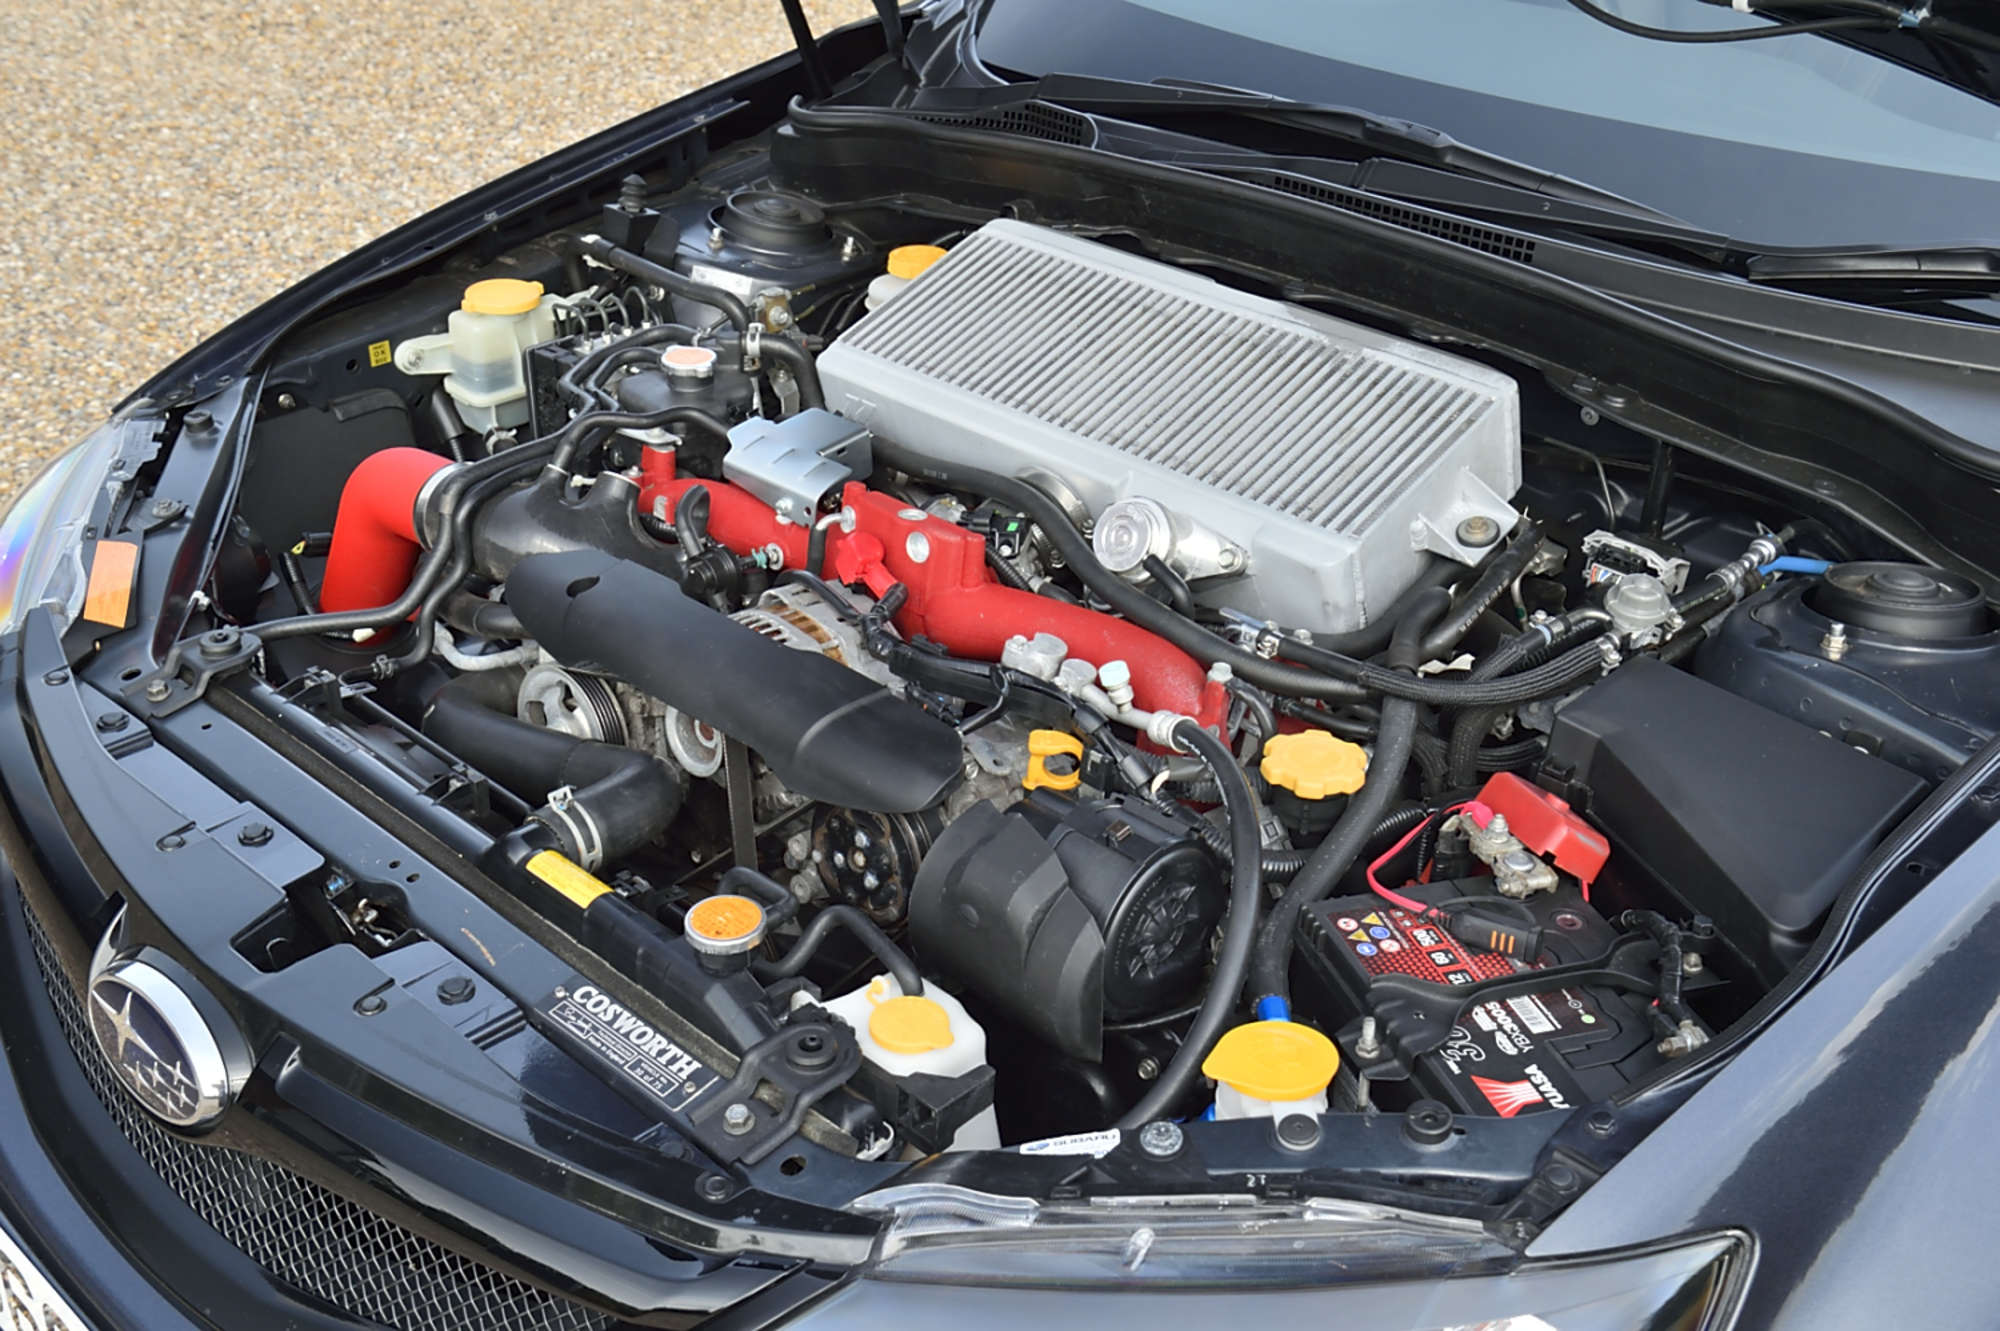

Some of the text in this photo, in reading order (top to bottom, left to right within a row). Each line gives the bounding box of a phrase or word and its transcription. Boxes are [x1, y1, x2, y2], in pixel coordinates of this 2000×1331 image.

[572, 985, 703, 1081] COSWORTH
[1484, 1000, 1535, 1054] YBX3005
[1523, 1063, 1571, 1109] YUASA
